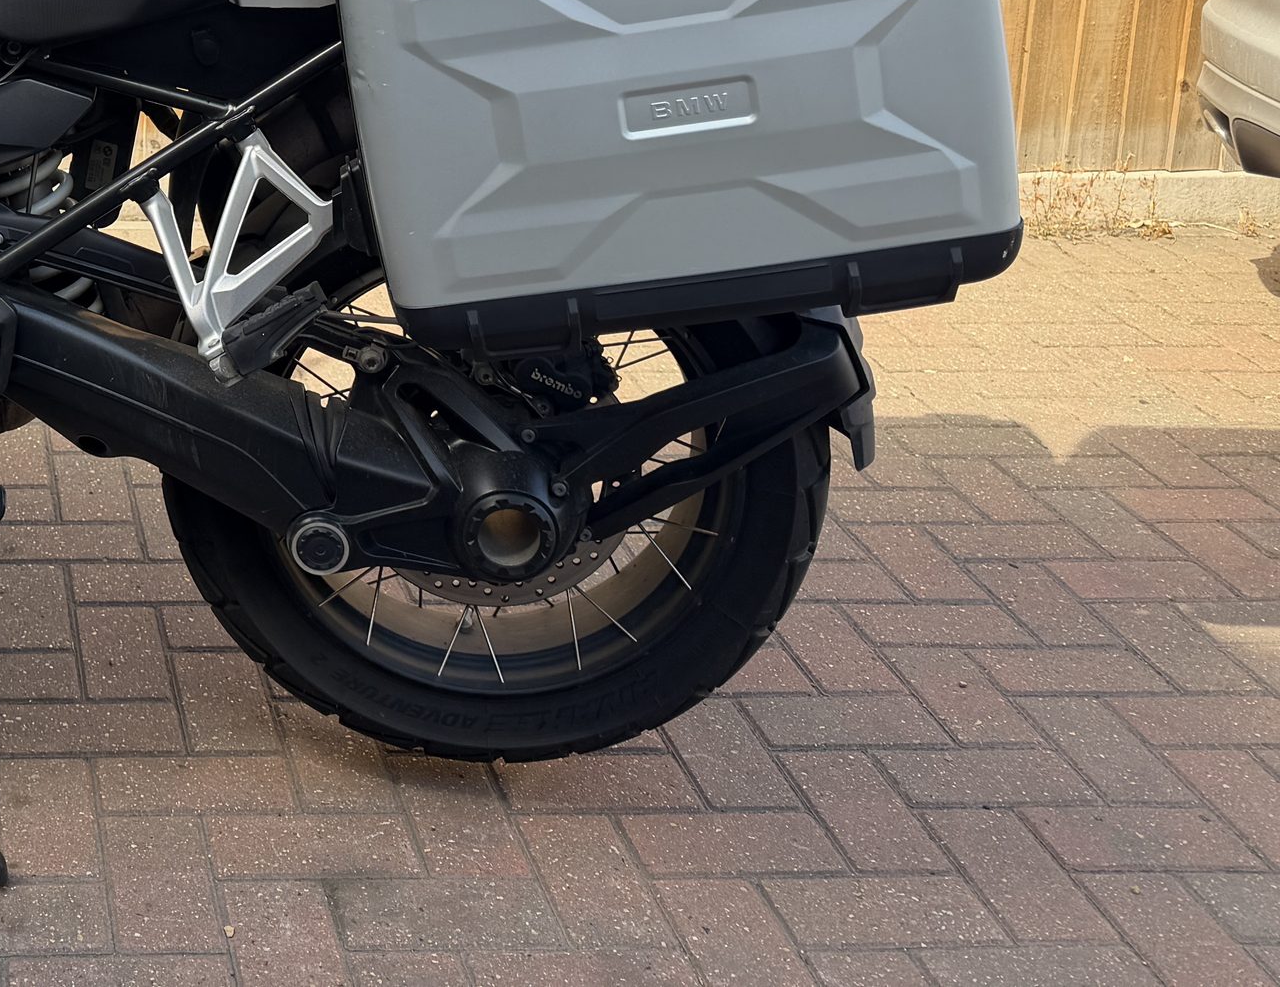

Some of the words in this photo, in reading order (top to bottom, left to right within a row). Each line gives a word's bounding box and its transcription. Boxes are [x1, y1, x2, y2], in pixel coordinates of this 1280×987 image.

[650, 92, 728, 121] BMW
[530, 368, 582, 399] brembo
[330, 667, 479, 729] ADVENTURE
